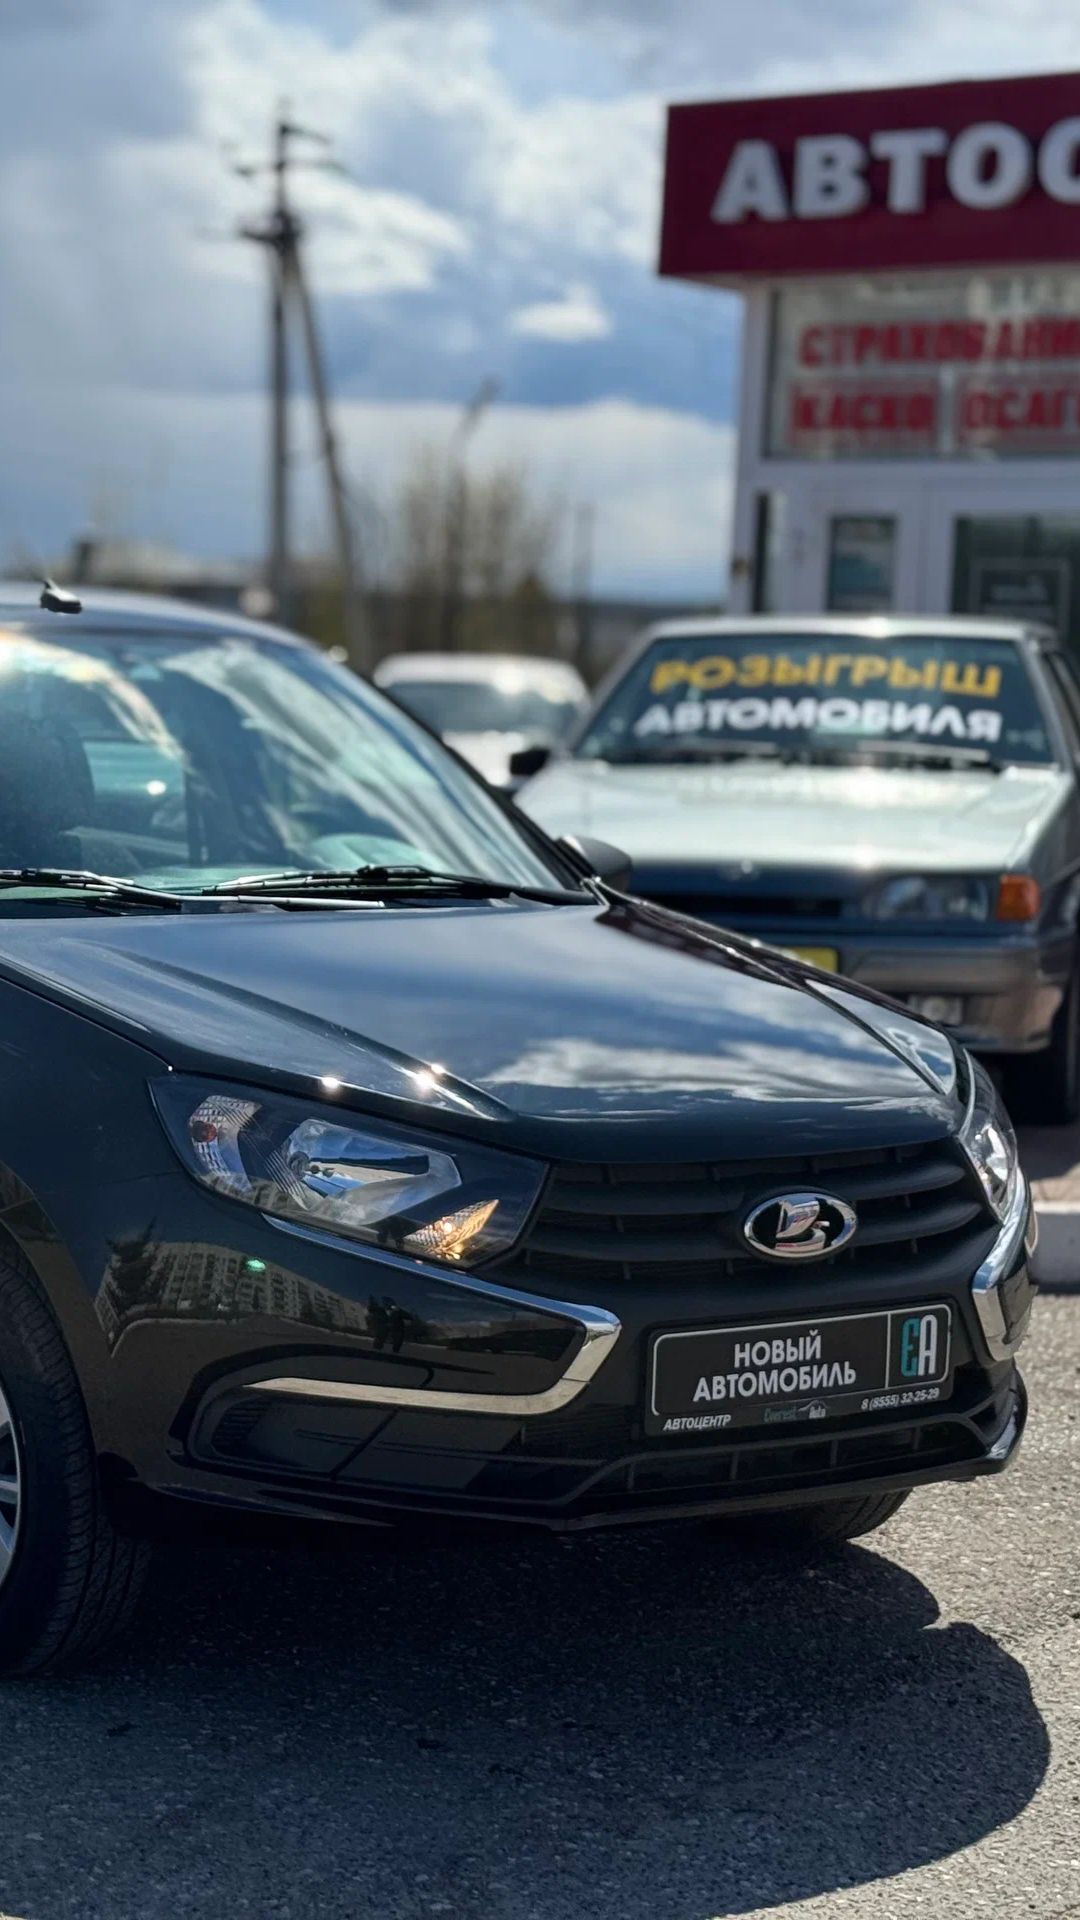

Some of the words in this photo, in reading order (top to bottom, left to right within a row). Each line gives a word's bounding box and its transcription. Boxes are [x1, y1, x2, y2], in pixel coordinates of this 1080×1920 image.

[794, 392, 937, 431] КАСКО
[965, 388, 1080, 430] ОСАГ
[651, 653, 1001, 697] РОЗЫГРЫШ
[634, 697, 1001, 743] АВТОМОБИЛЯ
[734, 1329, 822, 1368] НОВЫЙ
[693, 1360, 857, 1402] АВТОМОБИЛЬ
[808, 1406, 826, 1419] Auto
[861, 1398, 868, 1410] 8
[869, 1394, 899, 1411] (8555)
[663, 1414, 732, 1431] АВТОЦЕНТР
